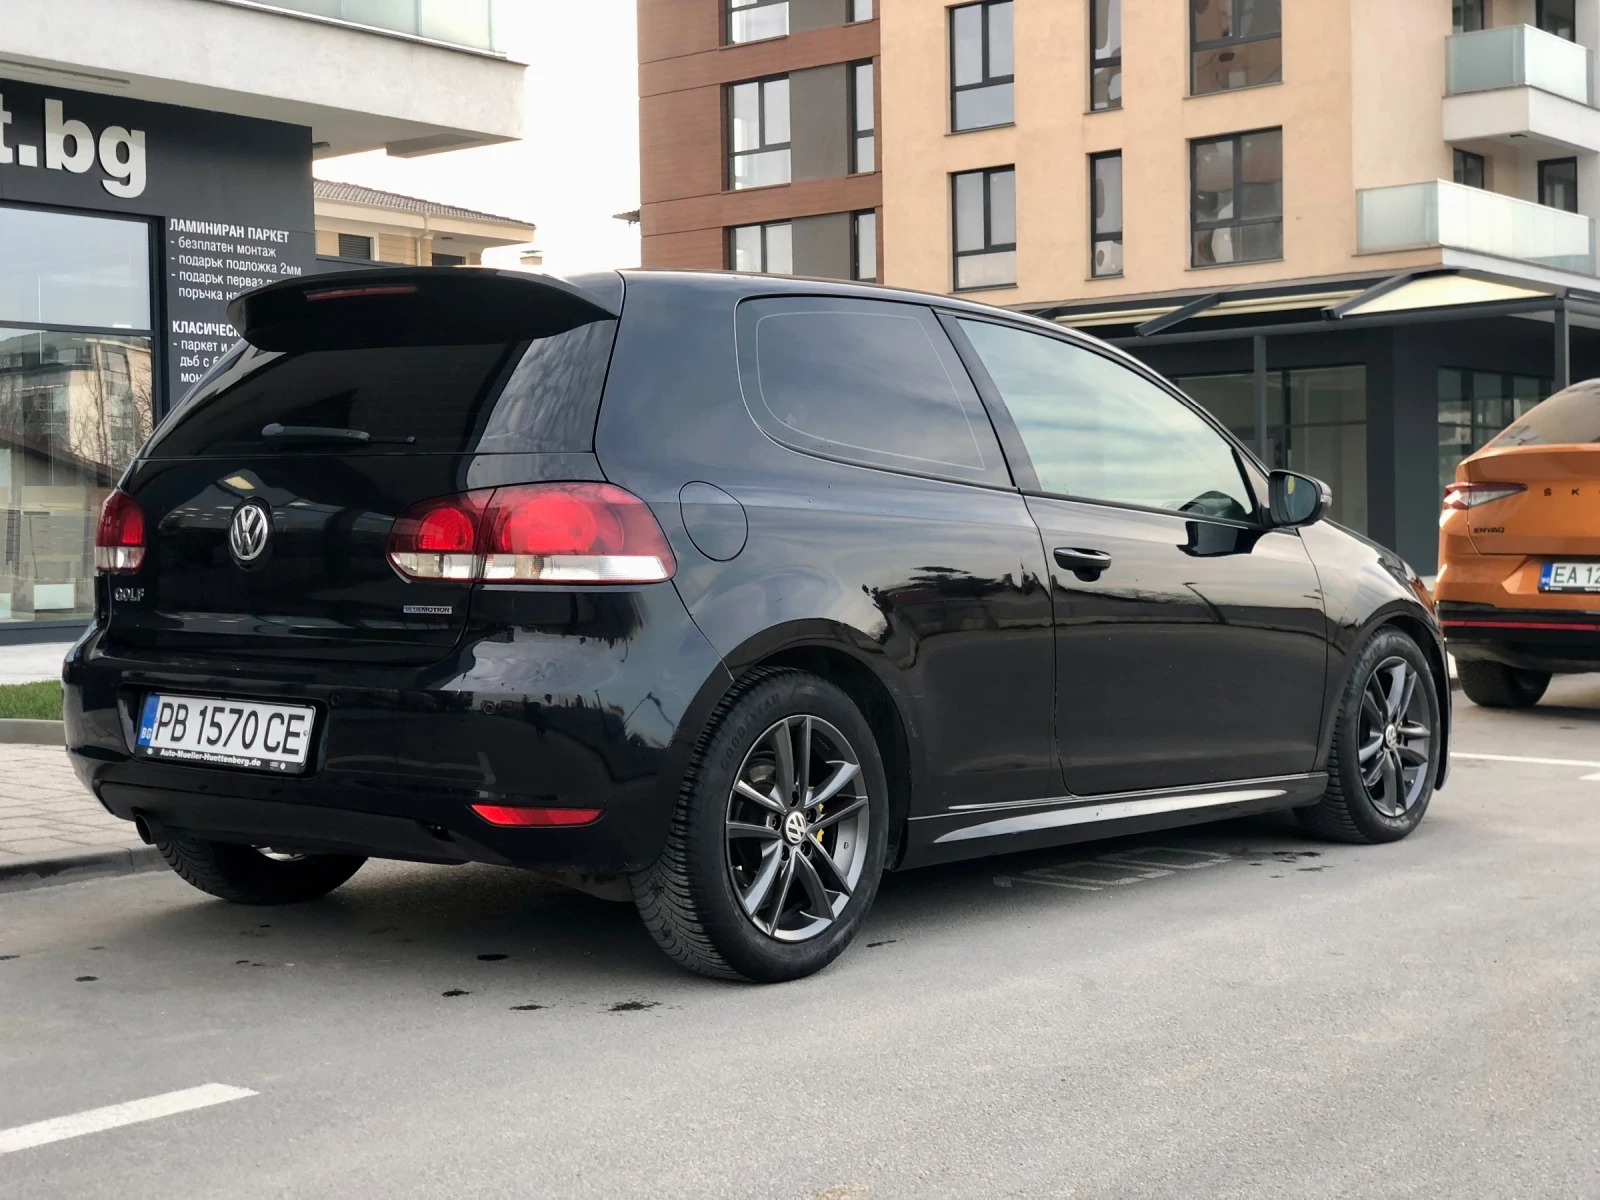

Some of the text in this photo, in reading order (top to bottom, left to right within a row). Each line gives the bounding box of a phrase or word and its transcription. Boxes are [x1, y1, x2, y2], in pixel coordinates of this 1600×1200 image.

[169, 218, 289, 243] ЛАМИНИРАН ПАРКЕТ
[178, 235, 234, 253] безплатен
[237, 245, 276, 258] монтаж
[178, 254, 224, 269] подарък
[226, 260, 277, 274] подложка
[280, 263, 302, 276] 2мм
[179, 271, 224, 286] подарък
[226, 275, 263, 289] перваз
[178, 287, 223, 301] поръчка
[181, 340, 218, 353] паркет
[220, 343, 228, 352] и
[180, 354, 200, 367] дъб
[1554, 566, 1577, 583] EA
[115, 587, 144, 601] GOLF
[140, 728, 153, 740] BG
[155, 702, 305, 755] PB 1570 CE
